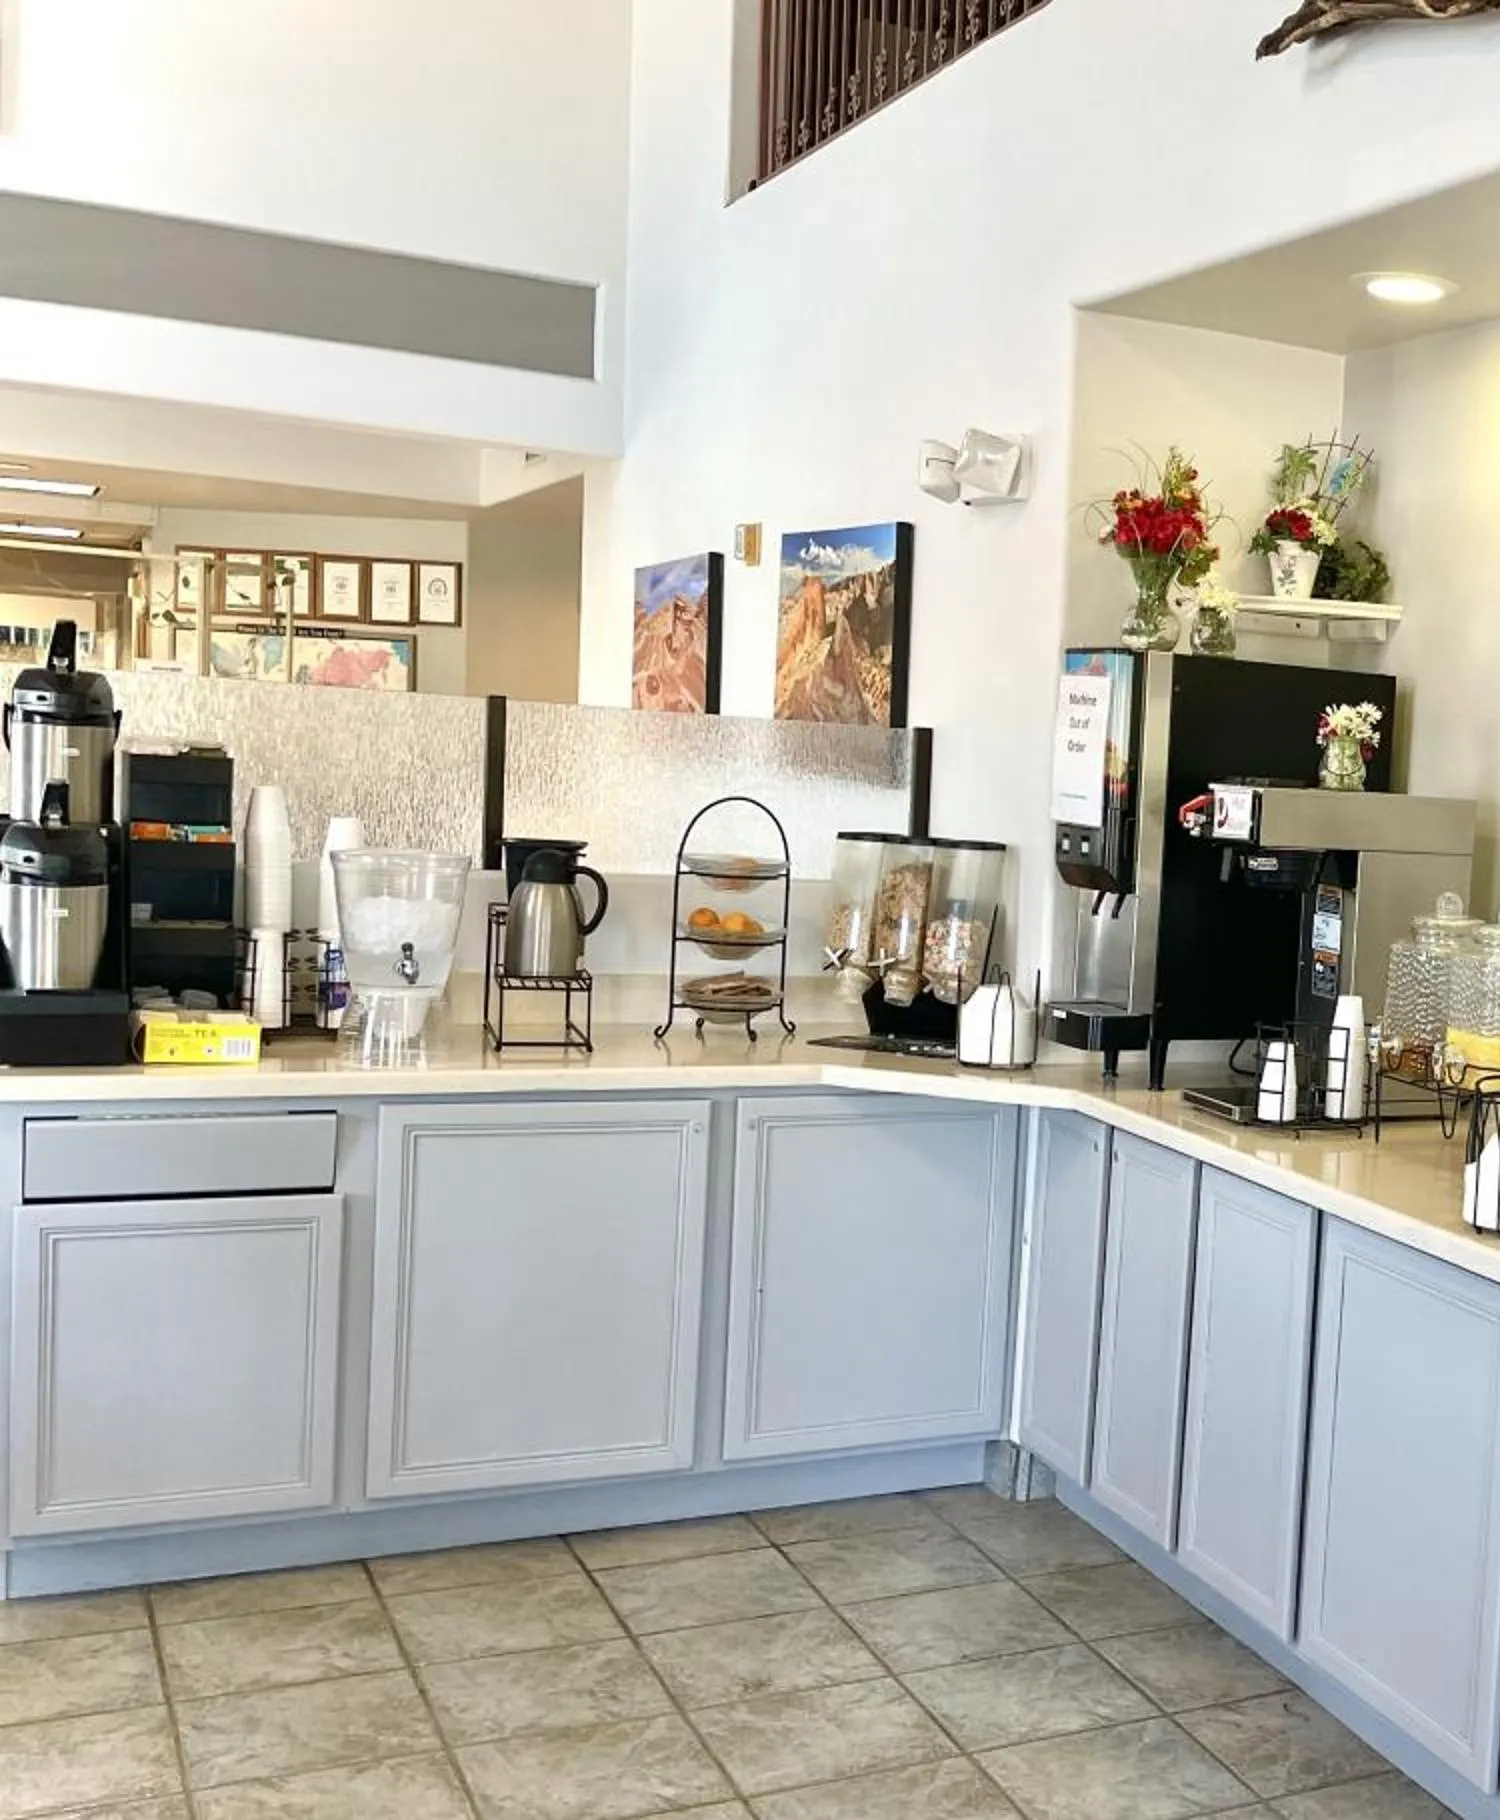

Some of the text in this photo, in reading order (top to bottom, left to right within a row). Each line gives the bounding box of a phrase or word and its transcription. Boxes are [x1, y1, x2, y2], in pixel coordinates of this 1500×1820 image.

[1069, 693, 1097, 706] Machine
[1069, 717, 1090, 729] Out of
[1067, 739, 1087, 752] Order
[194, 1029, 217, 1039] TEA
